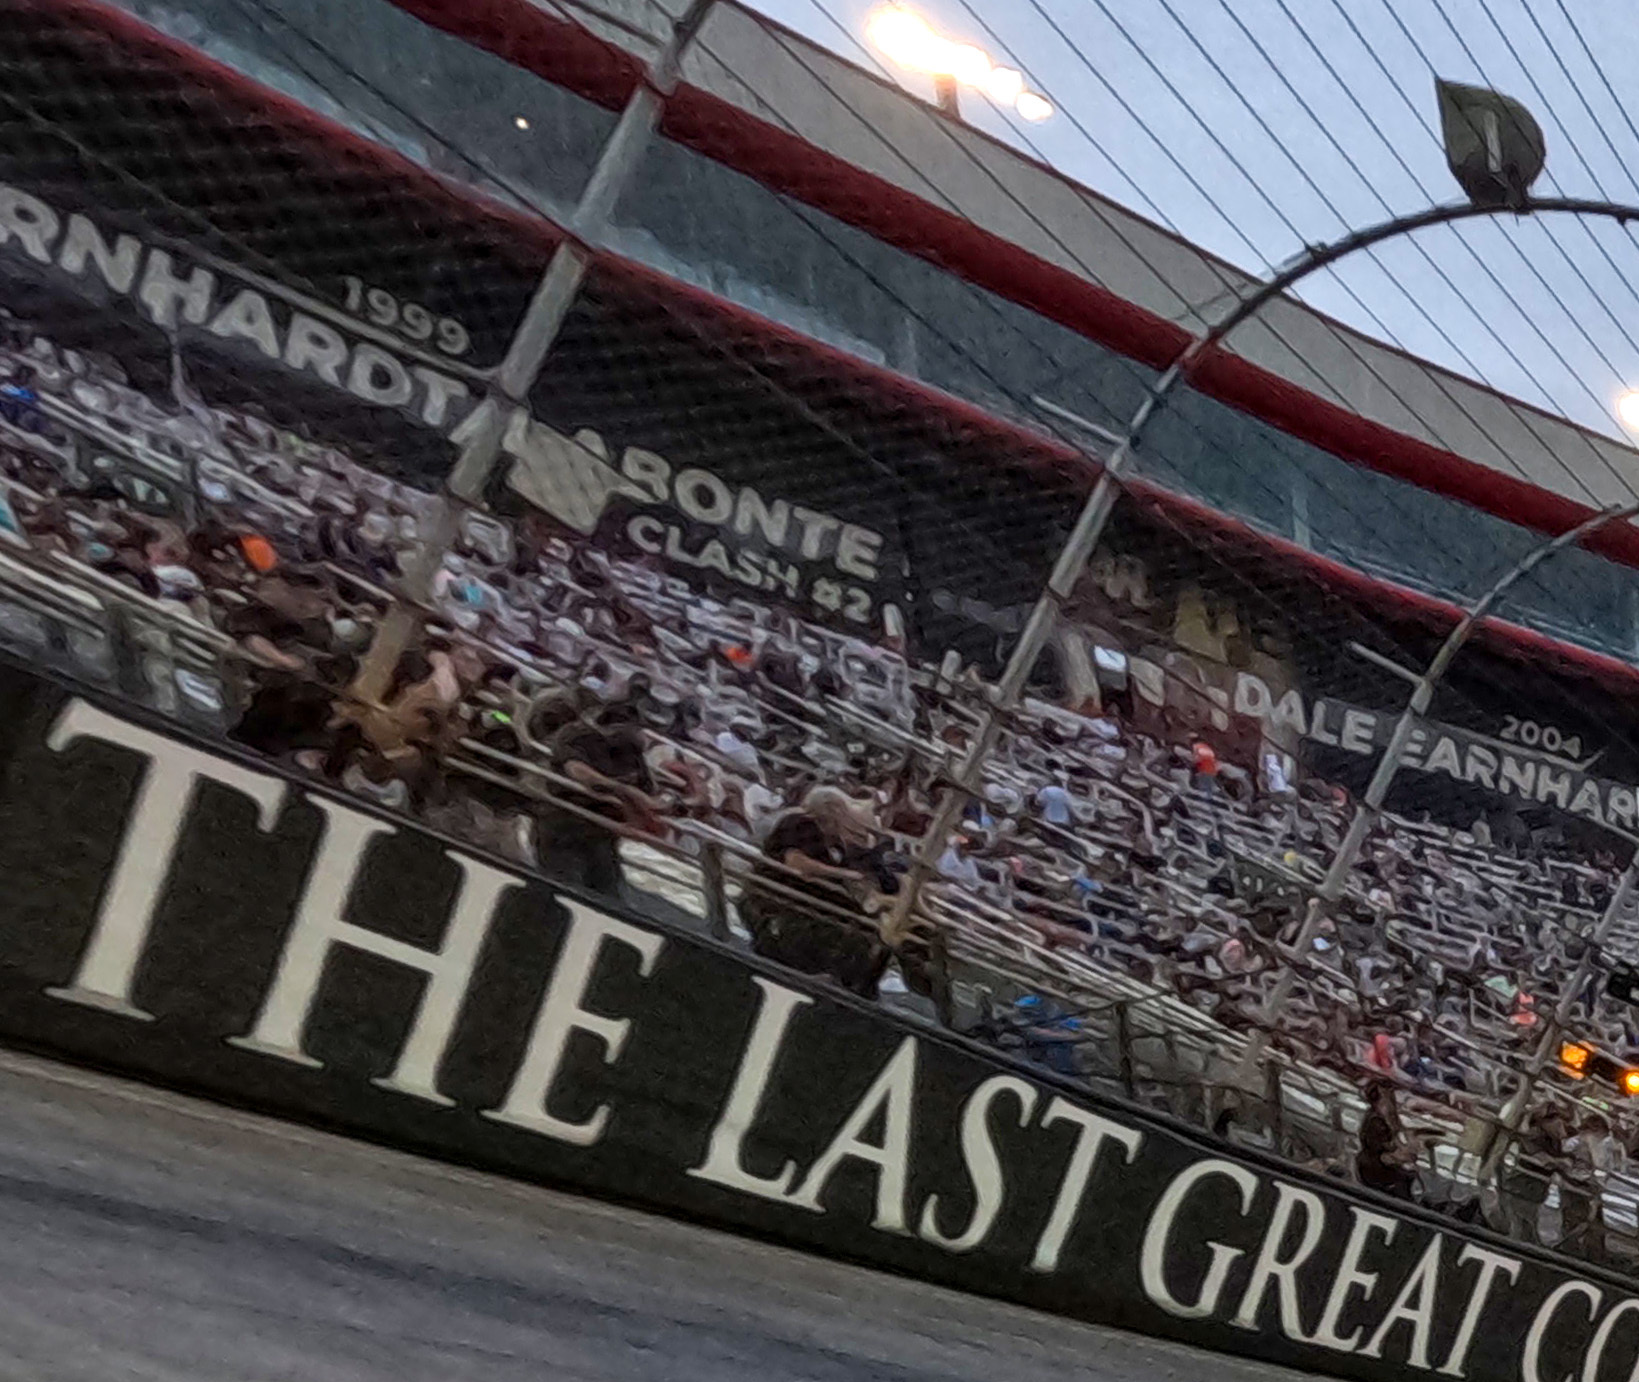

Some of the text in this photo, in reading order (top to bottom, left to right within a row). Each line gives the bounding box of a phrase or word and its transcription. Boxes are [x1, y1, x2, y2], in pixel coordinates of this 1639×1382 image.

[344, 277, 470, 354] 1999
[626, 515, 800, 598] CLASH
[1235, 671, 1378, 757] DALE
[1500, 715, 1582, 760] 2004
[44, 695, 667, 1147] THE
[686, 974, 1142, 1274] LAST
[1138, 1158, 1523, 1379] GREAT
